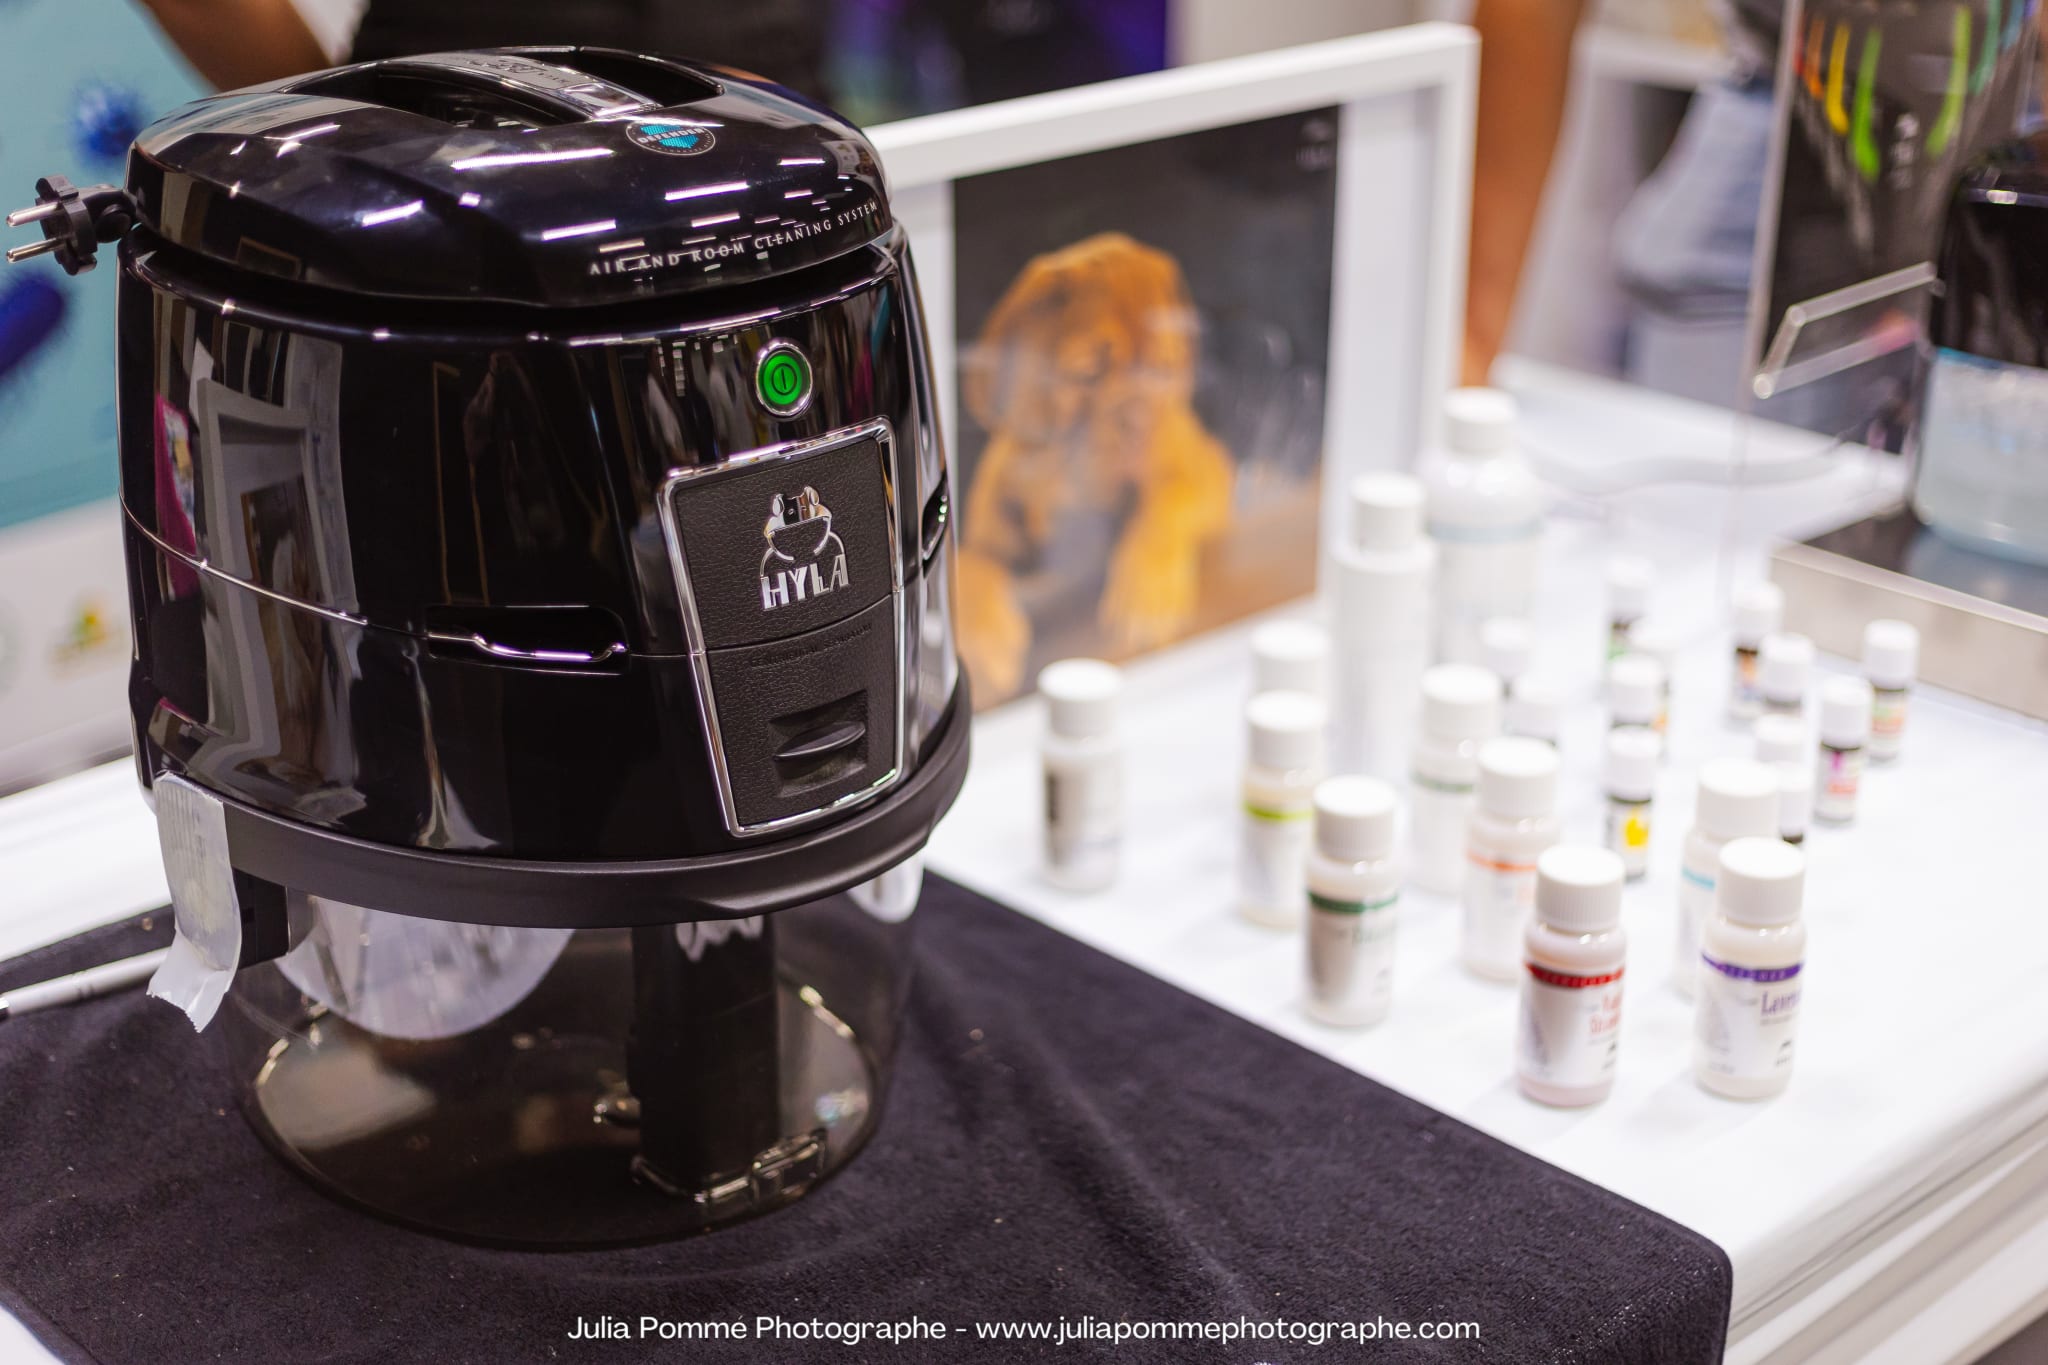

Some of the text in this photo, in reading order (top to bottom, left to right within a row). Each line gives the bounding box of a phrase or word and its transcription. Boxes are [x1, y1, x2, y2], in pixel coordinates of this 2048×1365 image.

[589, 201, 878, 275] AIR AND ROOM CLEANING SYSTEM
[760, 554, 849, 610] HYLA
